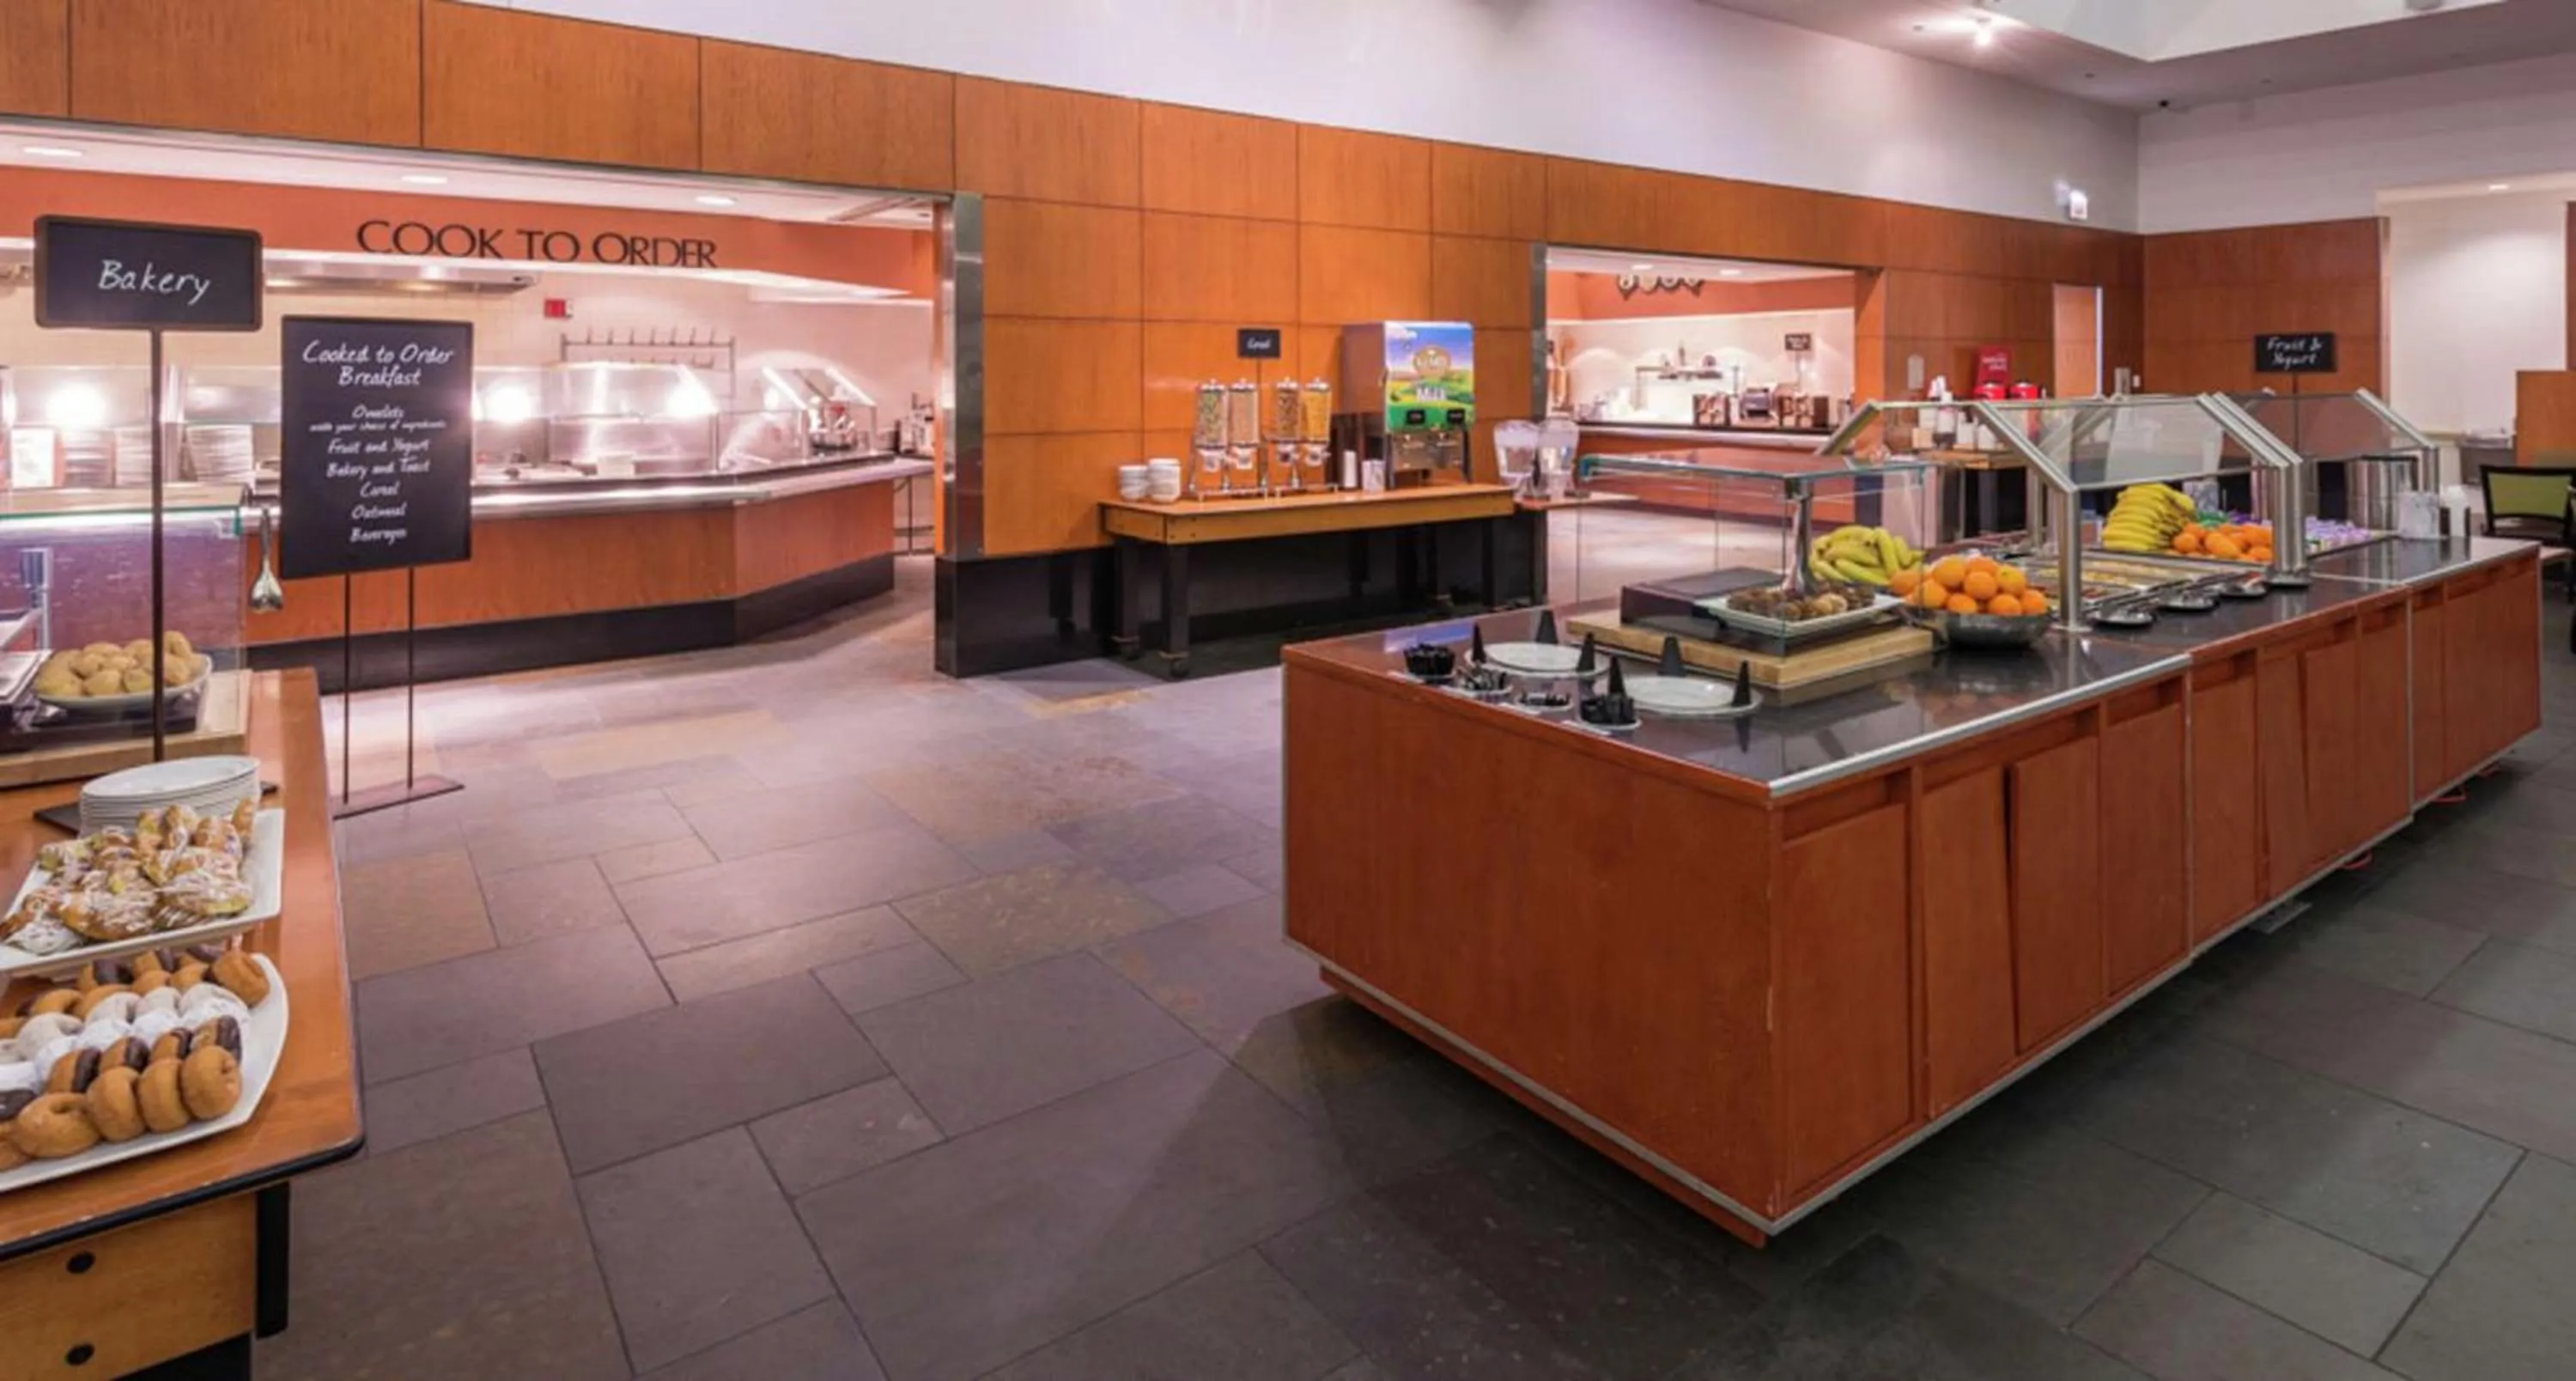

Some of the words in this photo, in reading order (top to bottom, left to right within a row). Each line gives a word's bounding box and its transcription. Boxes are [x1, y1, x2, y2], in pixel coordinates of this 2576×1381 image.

[356, 220, 503, 259] COOK
[517, 228, 580, 263] TO
[592, 232, 718, 269] ORDER
[98, 259, 211, 306] Bakery
[303, 340, 369, 362] Cooked
[376, 345, 394, 362] to
[399, 344, 453, 364] Order
[2267, 336, 2306, 351] Fruit
[2272, 351, 2317, 370] Yogurt
[337, 365, 422, 387] Breakfast
[327, 438, 361, 453] Fruit
[364, 441, 387, 453] and
[392, 436, 430, 456] Yogurt
[326, 462, 367, 480] Bakery
[371, 461, 395, 475] and
[351, 502, 408, 519] Oatmeal
